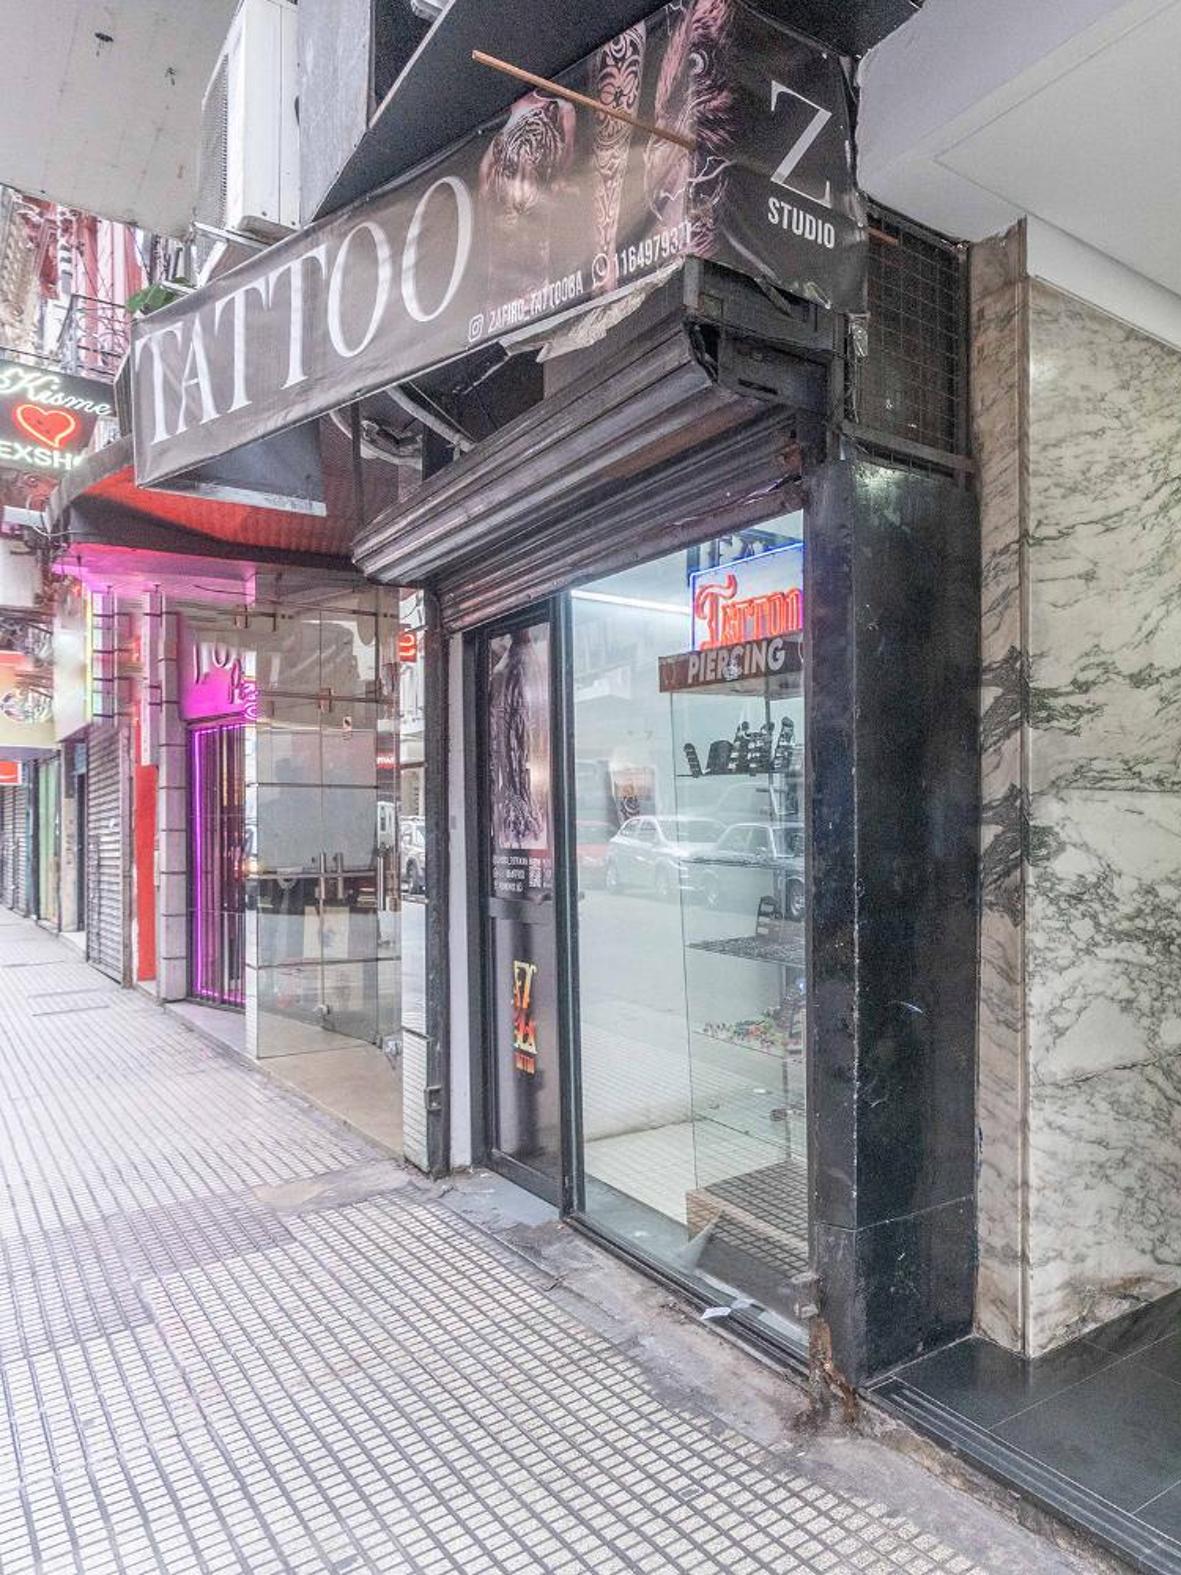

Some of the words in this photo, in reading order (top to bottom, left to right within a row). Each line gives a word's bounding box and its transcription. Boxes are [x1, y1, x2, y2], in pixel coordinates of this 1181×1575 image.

[769, 79, 833, 209] Z
[767, 197, 836, 250] STUDIO
[134, 175, 473, 445] TATTOO
[687, 637, 785, 684] PIERCING
